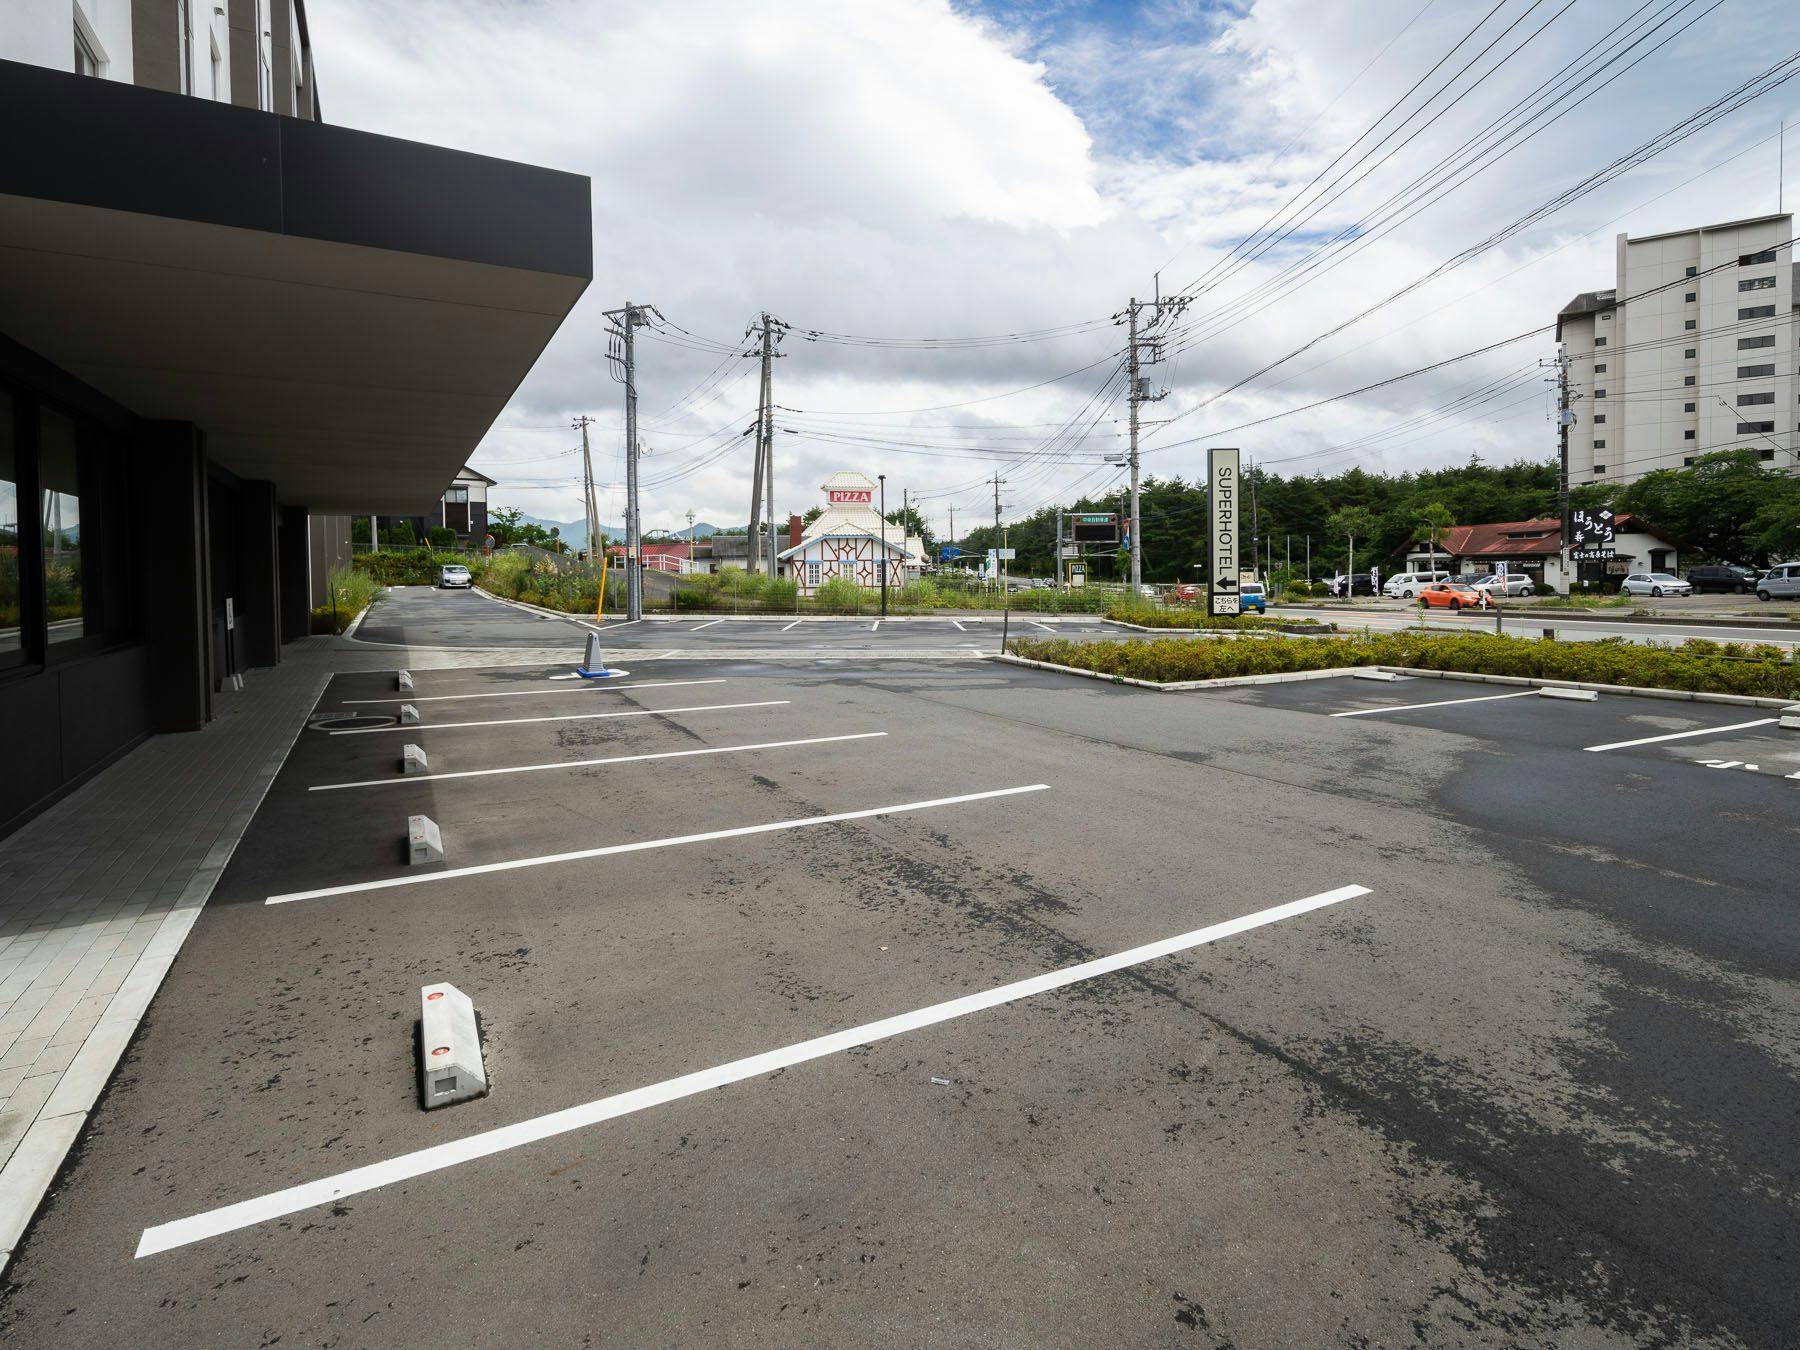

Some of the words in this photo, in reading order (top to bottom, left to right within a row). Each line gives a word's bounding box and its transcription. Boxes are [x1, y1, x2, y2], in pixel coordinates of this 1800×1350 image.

[833, 491, 869, 502] PIZZA
[1218, 466, 1233, 576] SUPERHOTEL
[1573, 510, 1613, 542] ほうとう
[1215, 597, 1239, 605] こちらを
[1219, 604, 1235, 613] 左へ
